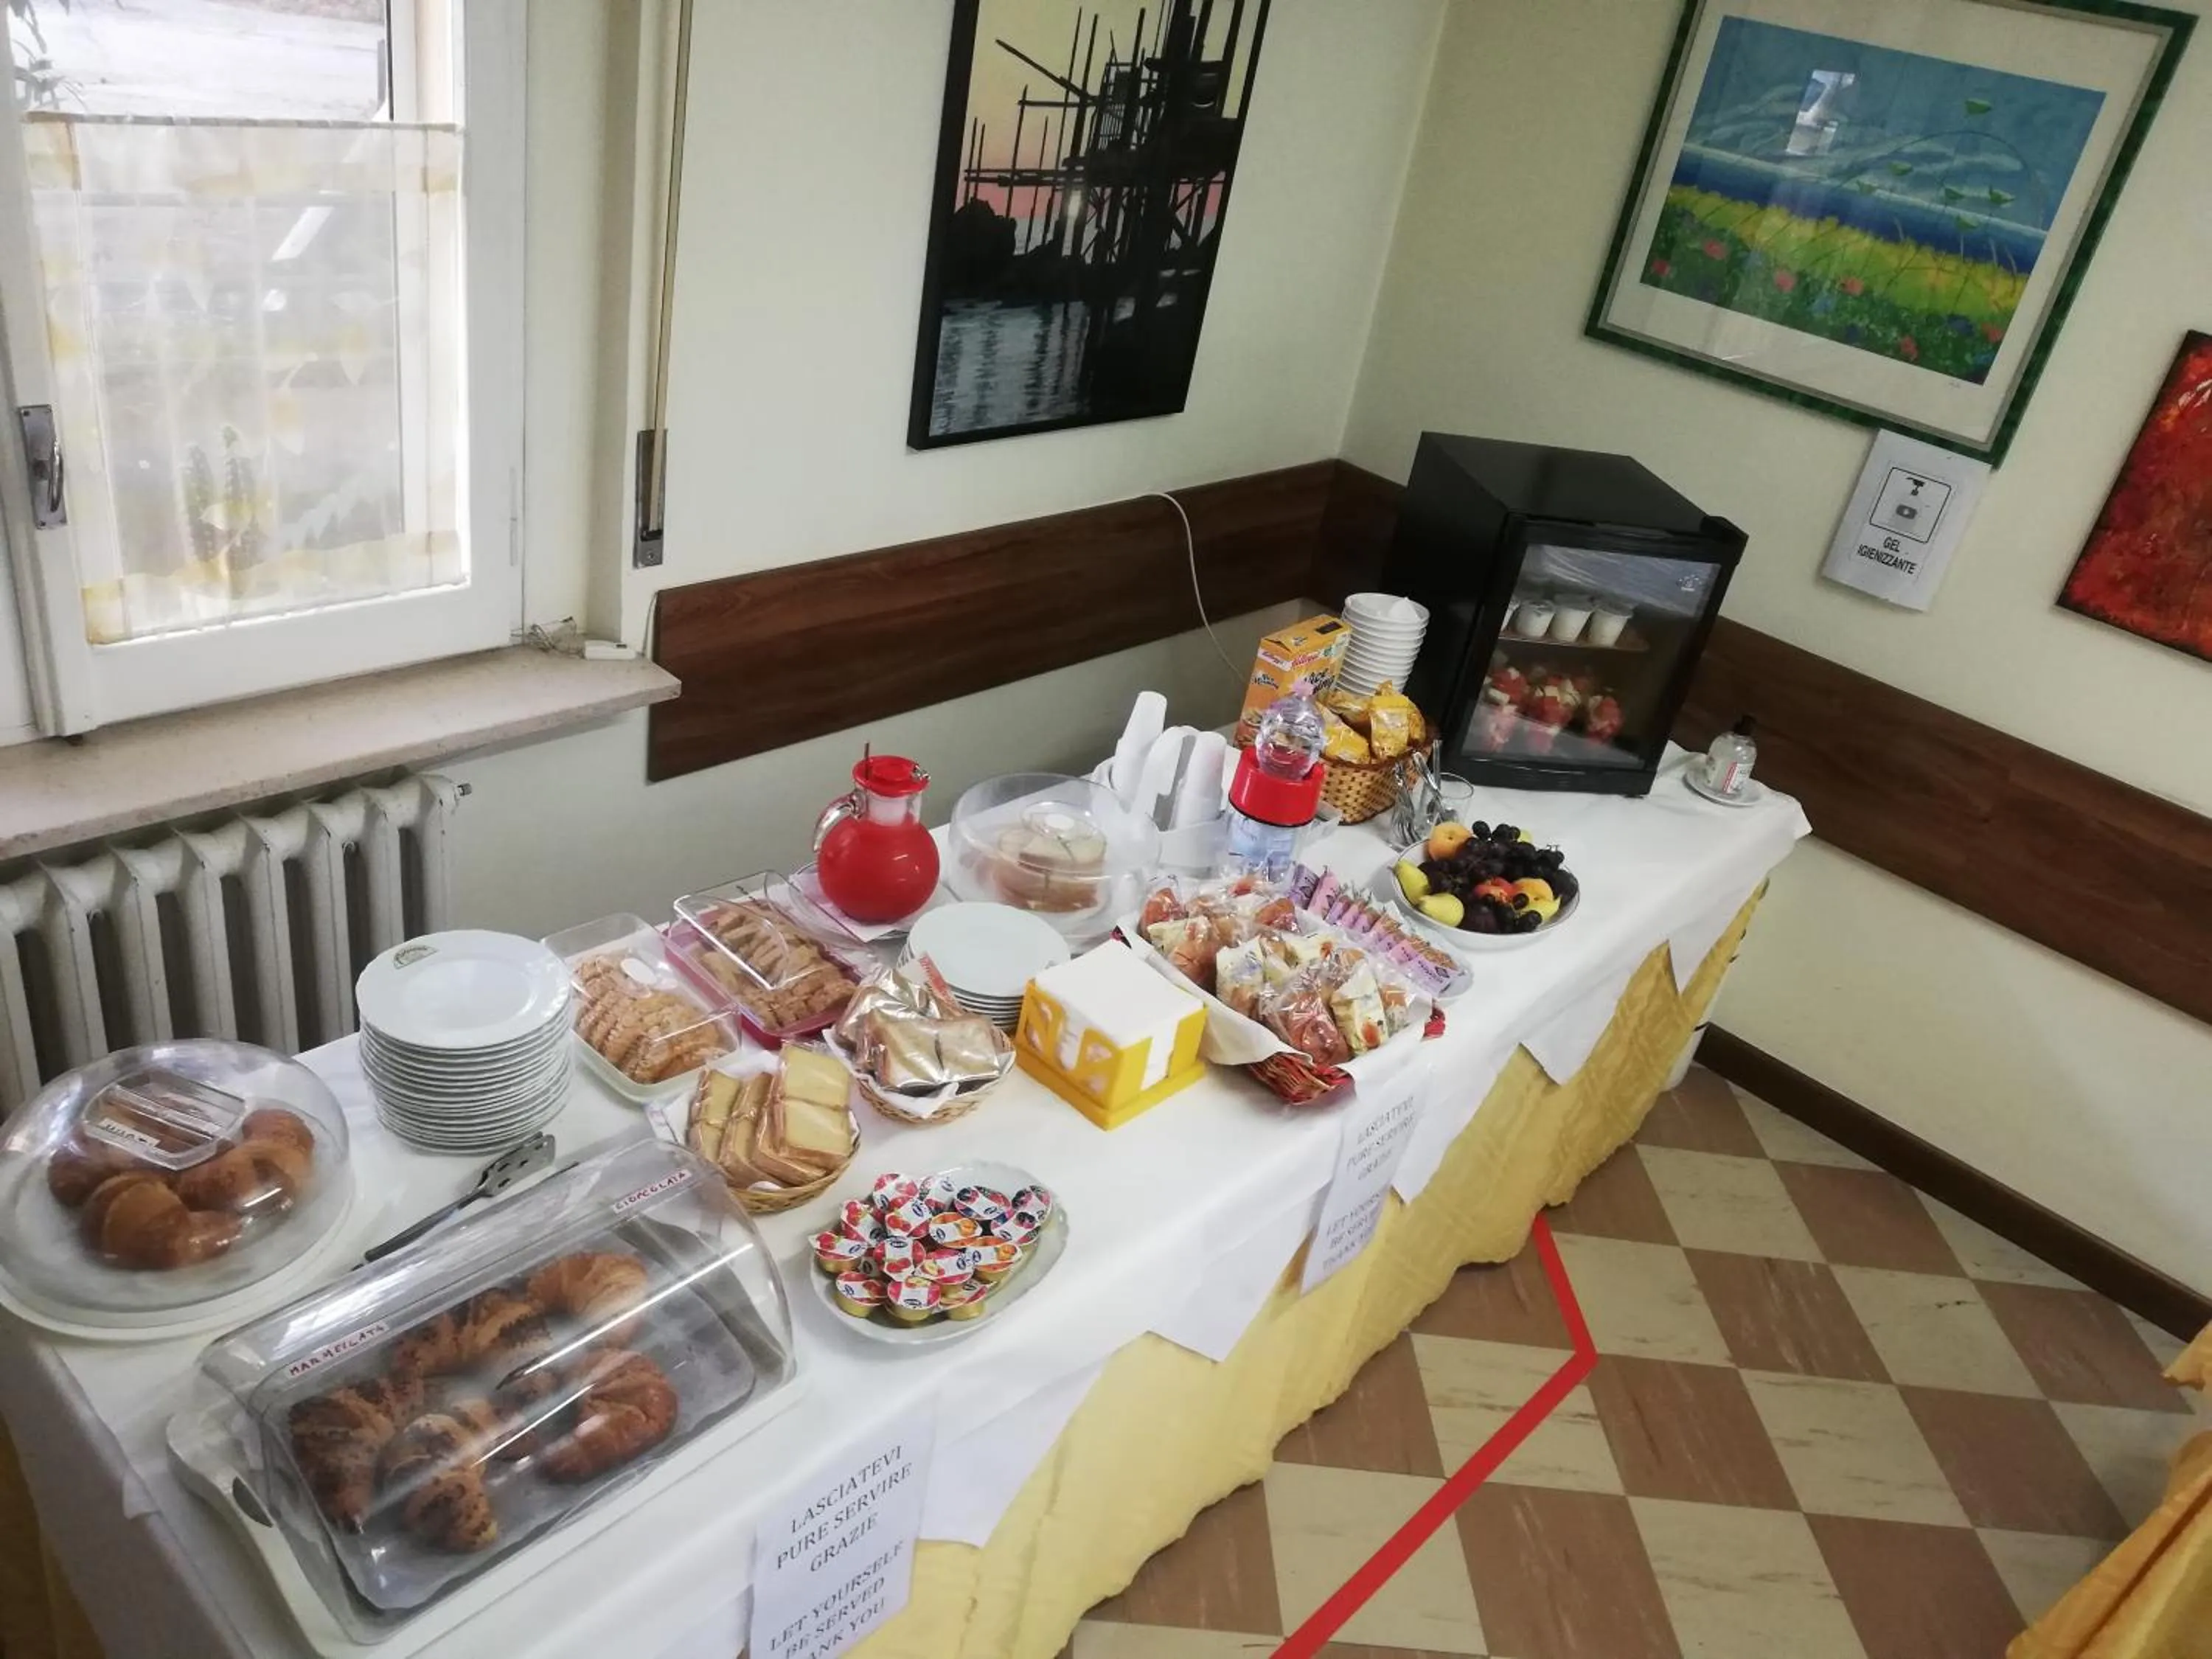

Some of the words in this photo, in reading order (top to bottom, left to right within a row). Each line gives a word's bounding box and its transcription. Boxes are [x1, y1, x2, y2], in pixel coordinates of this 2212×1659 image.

[1857, 544, 1917, 574] IGIENIZZANTE
[1882, 536, 1901, 552] GEL
[776, 1521, 829, 1570] PURE
[833, 1461, 912, 1529] SERVIRE
[790, 1445, 902, 1534] LASCIATEVI
[810, 1512, 878, 1573] GRAZIE
[770, 1615, 808, 1651] LET
[812, 1539, 904, 1618] YOURSELF
[814, 1576, 885, 1639] SERVED
